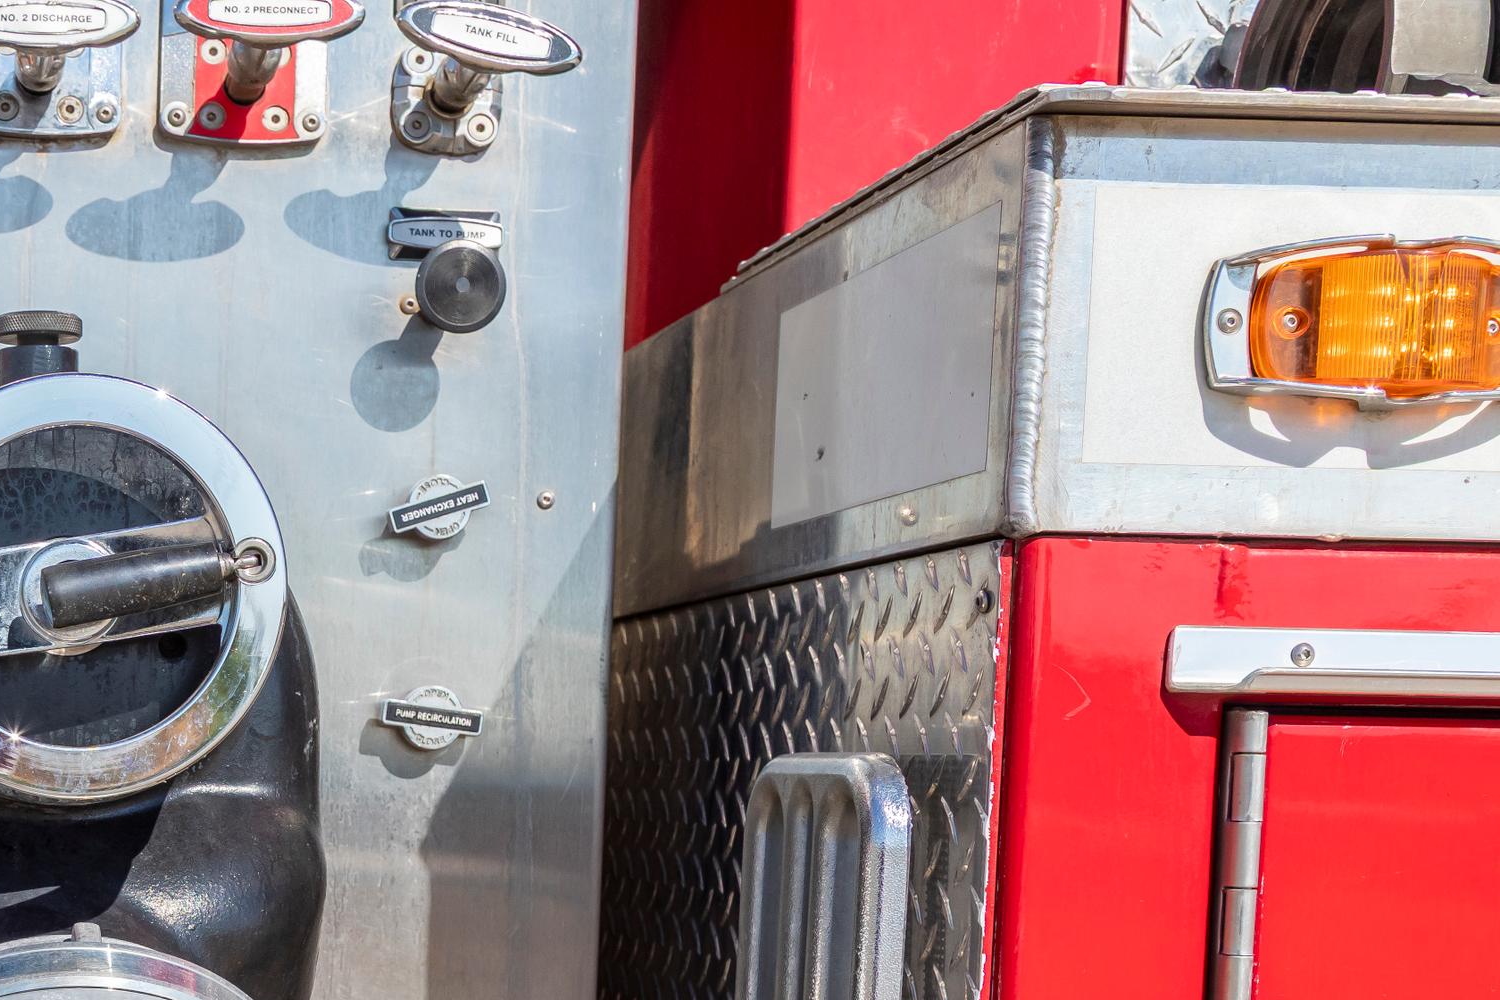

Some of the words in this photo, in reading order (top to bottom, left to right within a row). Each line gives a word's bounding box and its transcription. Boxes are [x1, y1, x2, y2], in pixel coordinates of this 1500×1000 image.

[224, 5, 241, 14] NO.
[245, 5, 250, 13] 2
[253, 5, 320, 14] PRECONNECT
[0, 13, 19, 22] NO.
[22, 13, 28, 21] 2
[31, 13, 92, 23] DISCHARGE
[465, 24, 493, 38] TANK
[496, 32, 519, 44] FILL
[409, 228, 435, 237] TANK
[440, 229, 453, 238] TO
[456, 230, 486, 239] PUMP
[456, 491, 479, 507] HEAT
[400, 499, 456, 522] EXCHANGER
[395, 708, 417, 720] PUMP
[417, 711, 472, 727] RECIRCULATION
